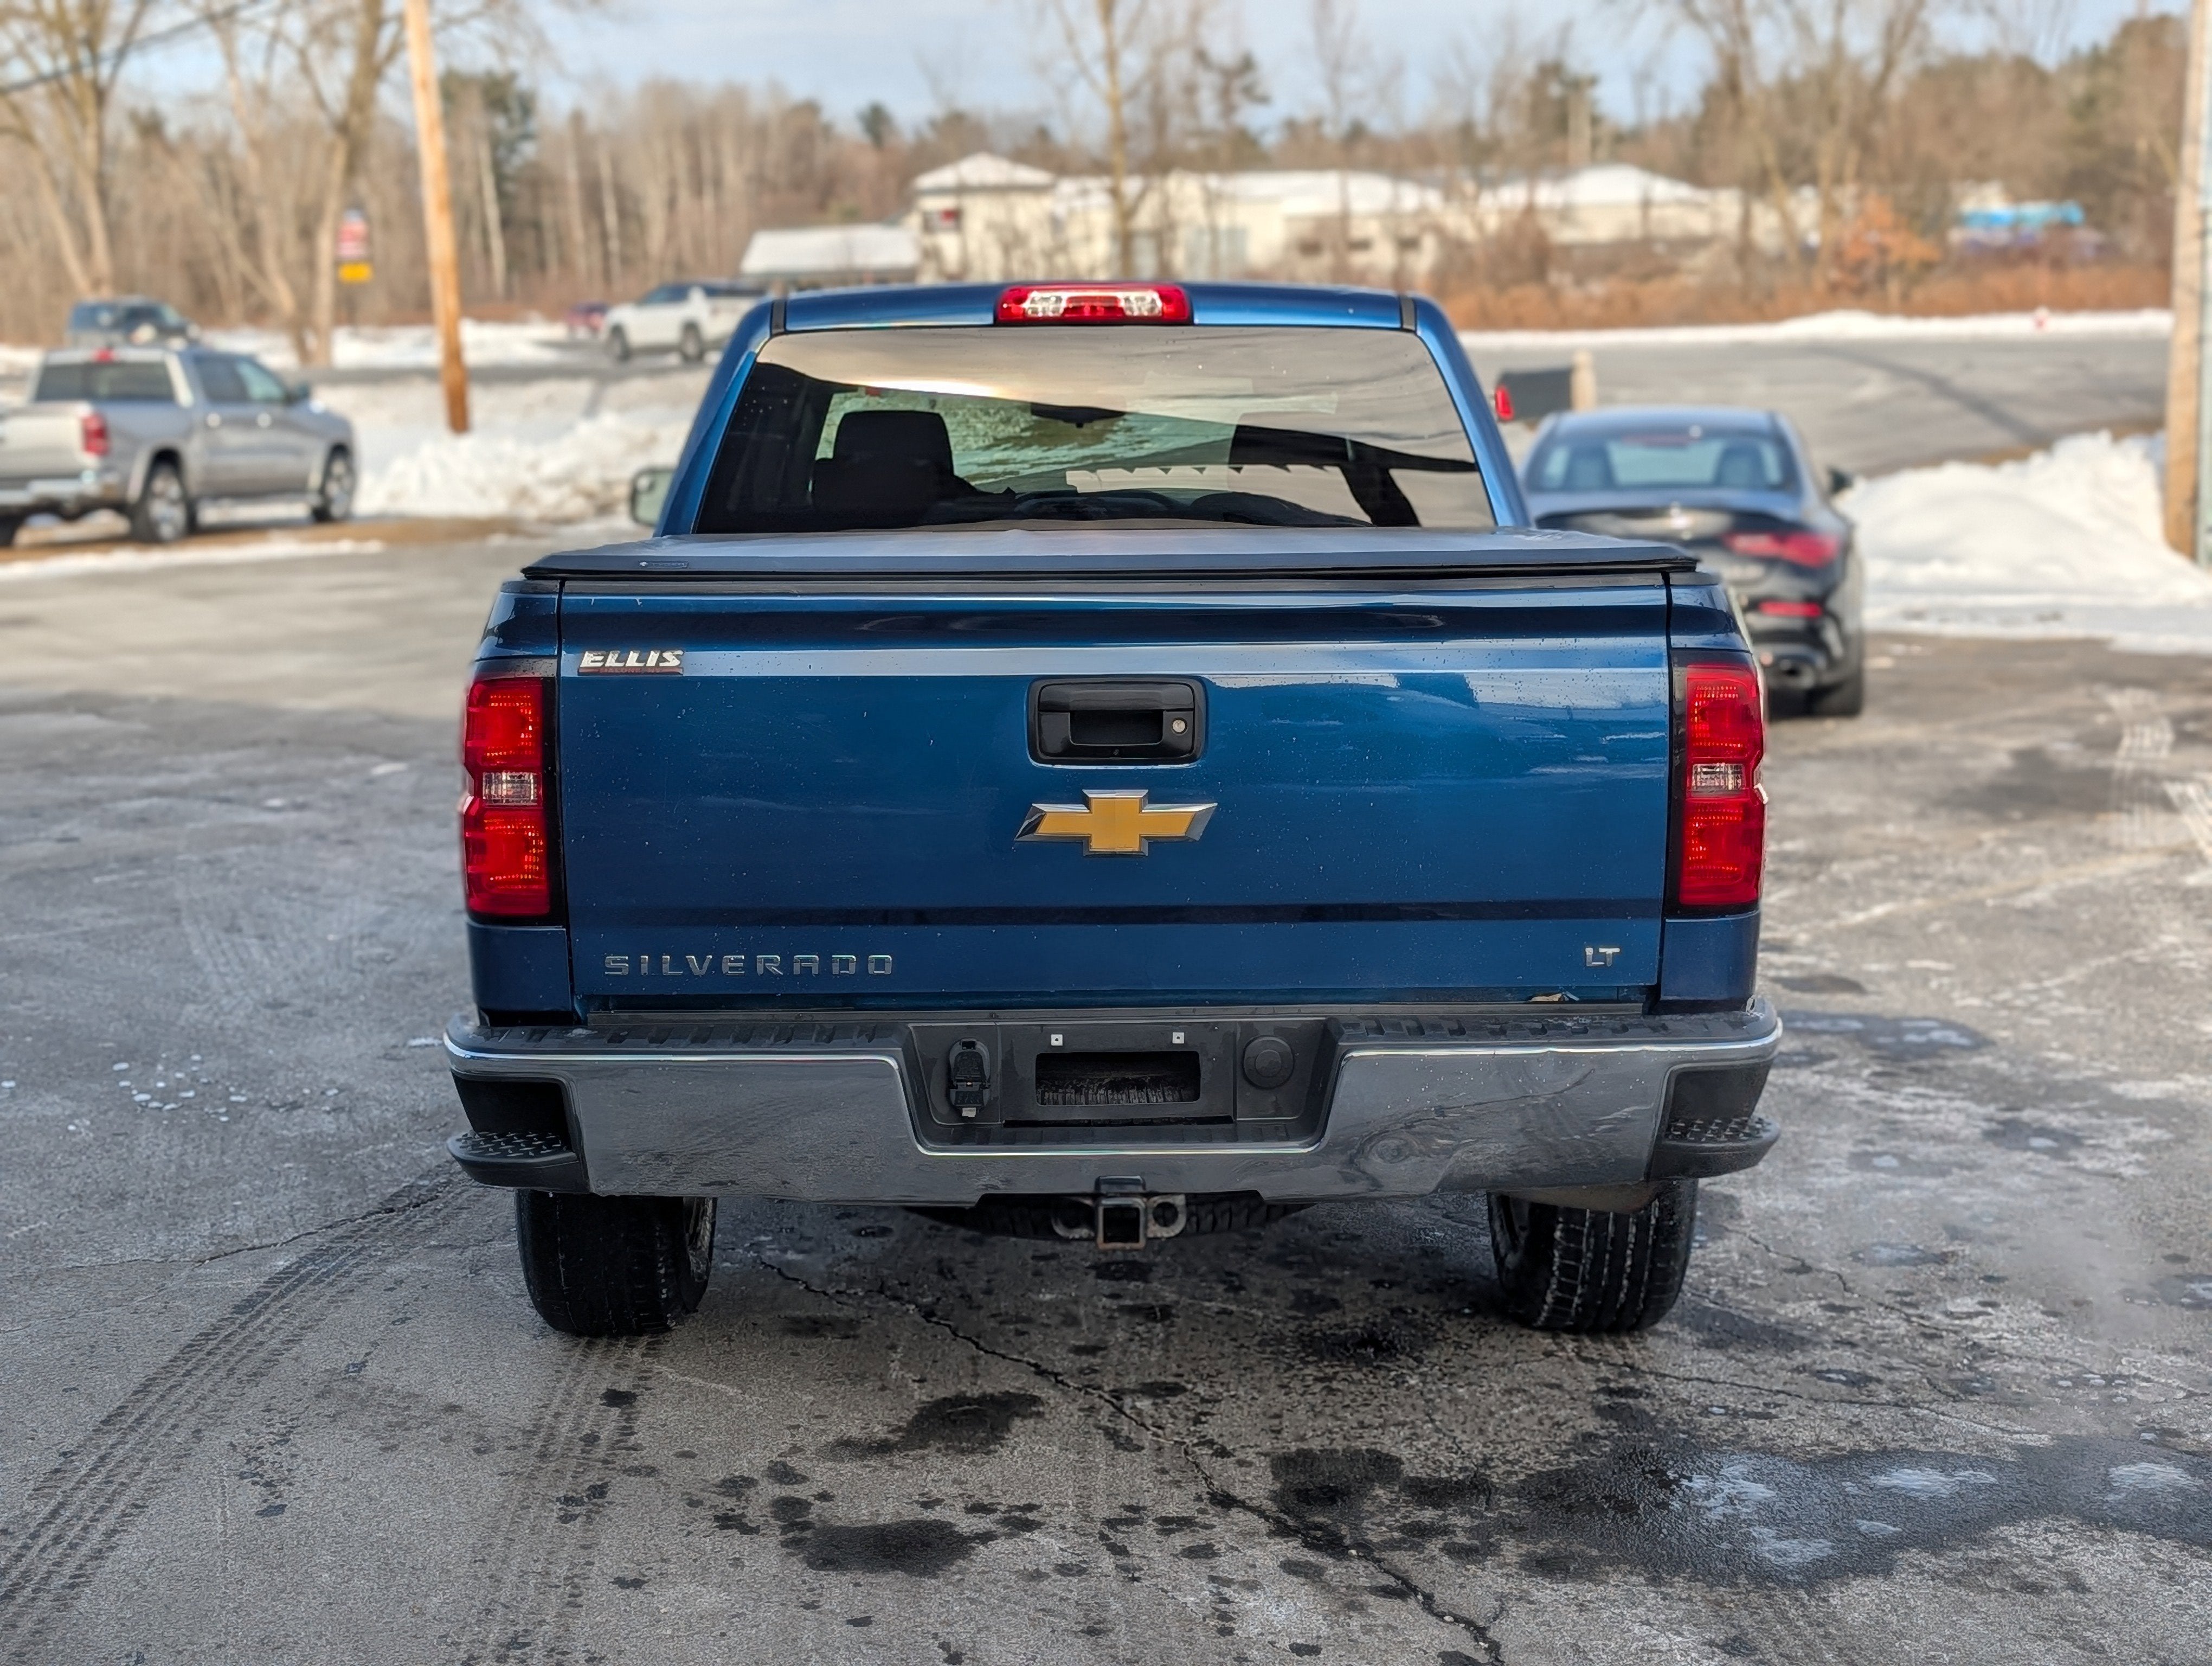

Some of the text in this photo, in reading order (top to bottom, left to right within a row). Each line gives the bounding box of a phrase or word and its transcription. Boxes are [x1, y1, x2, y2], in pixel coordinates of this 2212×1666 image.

[580, 650, 683, 667] ELLIS
[605, 955, 892, 976] SILVERADO
[1585, 947, 1621, 966] LT
